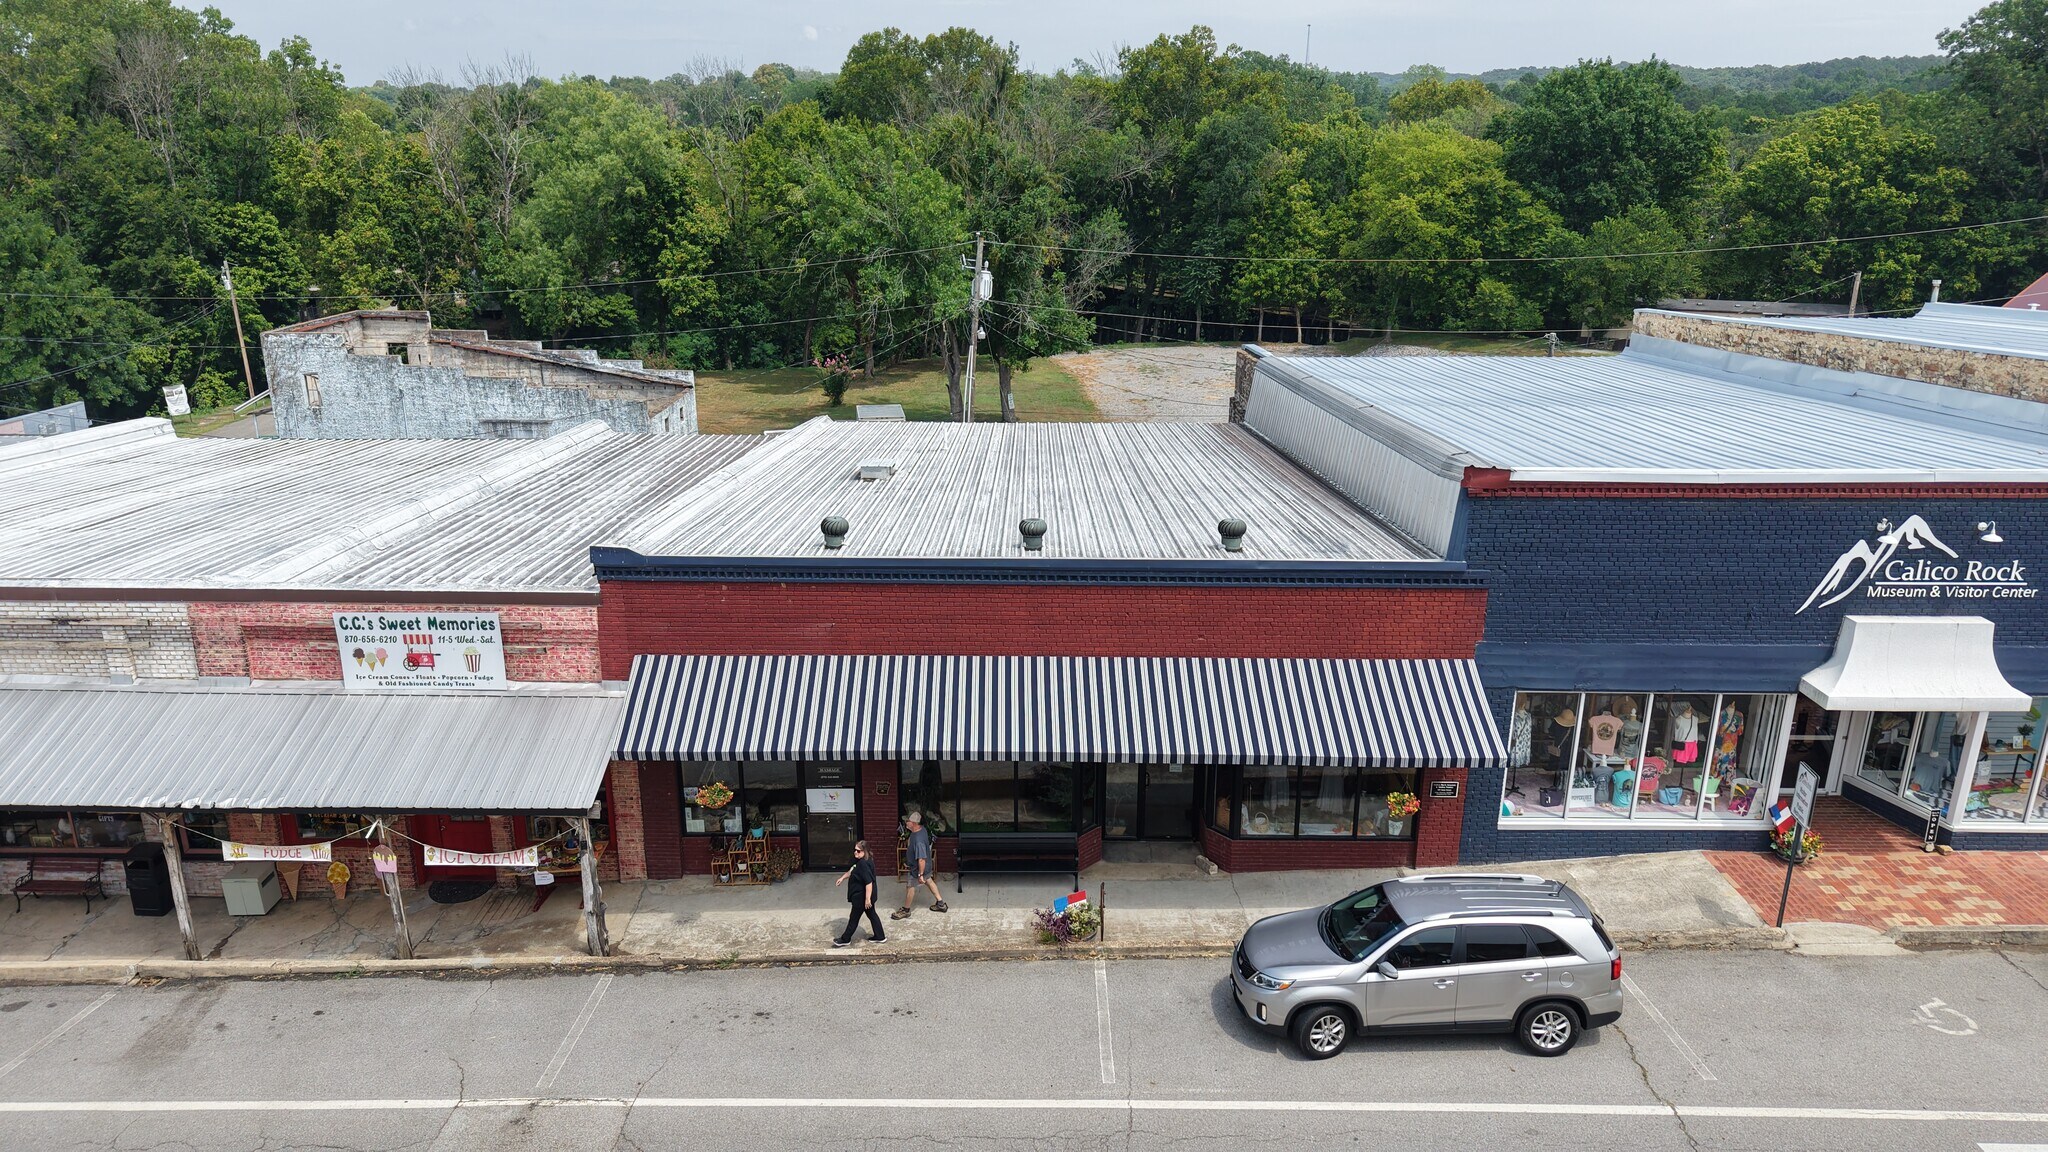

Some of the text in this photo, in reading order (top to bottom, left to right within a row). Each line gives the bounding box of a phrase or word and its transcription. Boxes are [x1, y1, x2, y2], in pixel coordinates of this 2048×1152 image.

[1884, 559, 2026, 582] Calico Rock
[1866, 585, 2039, 599] Museum & Visitor Center
[338, 615, 496, 631] C.C.'s Sweet Memories
[344, 635, 398, 644] 870-656-6210
[437, 635, 453, 644] 11-5
[263, 847, 302, 859] FUDGE
[439, 848, 525, 865] ICE CREAM
